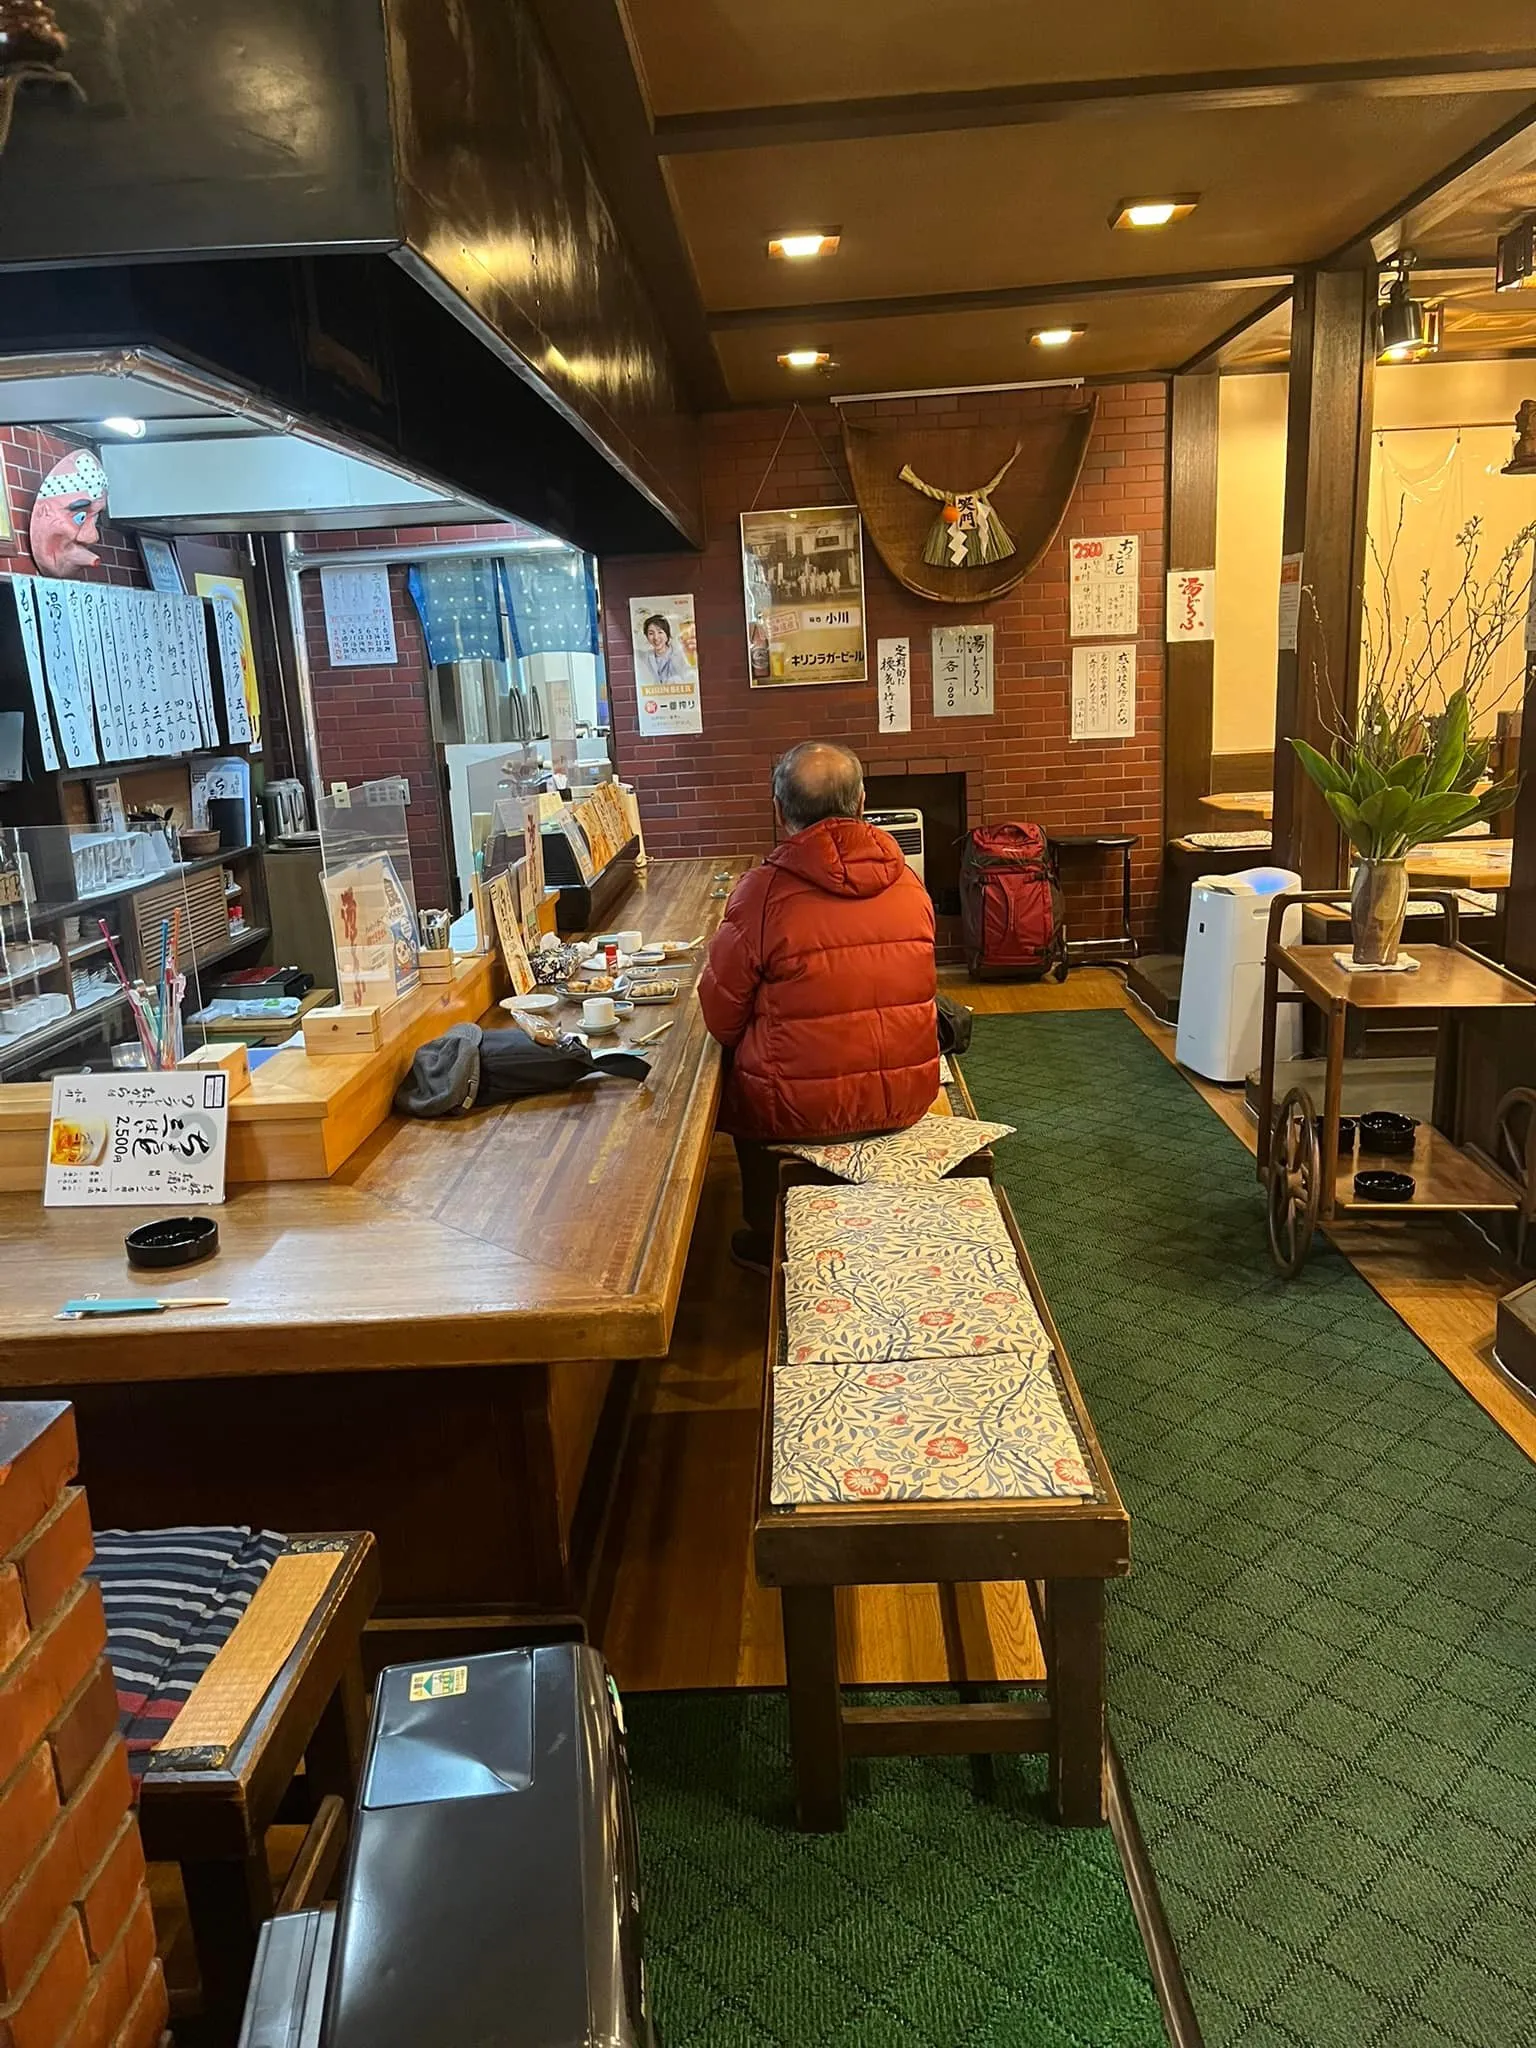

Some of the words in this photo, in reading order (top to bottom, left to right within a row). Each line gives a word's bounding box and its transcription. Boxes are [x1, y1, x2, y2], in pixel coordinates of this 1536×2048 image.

[957, 496, 976, 528] 笑門
[1073, 541, 1102, 559] 2500
[1178, 577, 1205, 630] 湯どうふ
[825, 611, 849, 625] 小川
[791, 650, 865, 667] キリンラガービール
[966, 634, 985, 696] 湯どうふ
[645, 686, 669, 696] KIRIN
[670, 684, 692, 695] BEER
[166, 1170, 193, 1185] お酒
